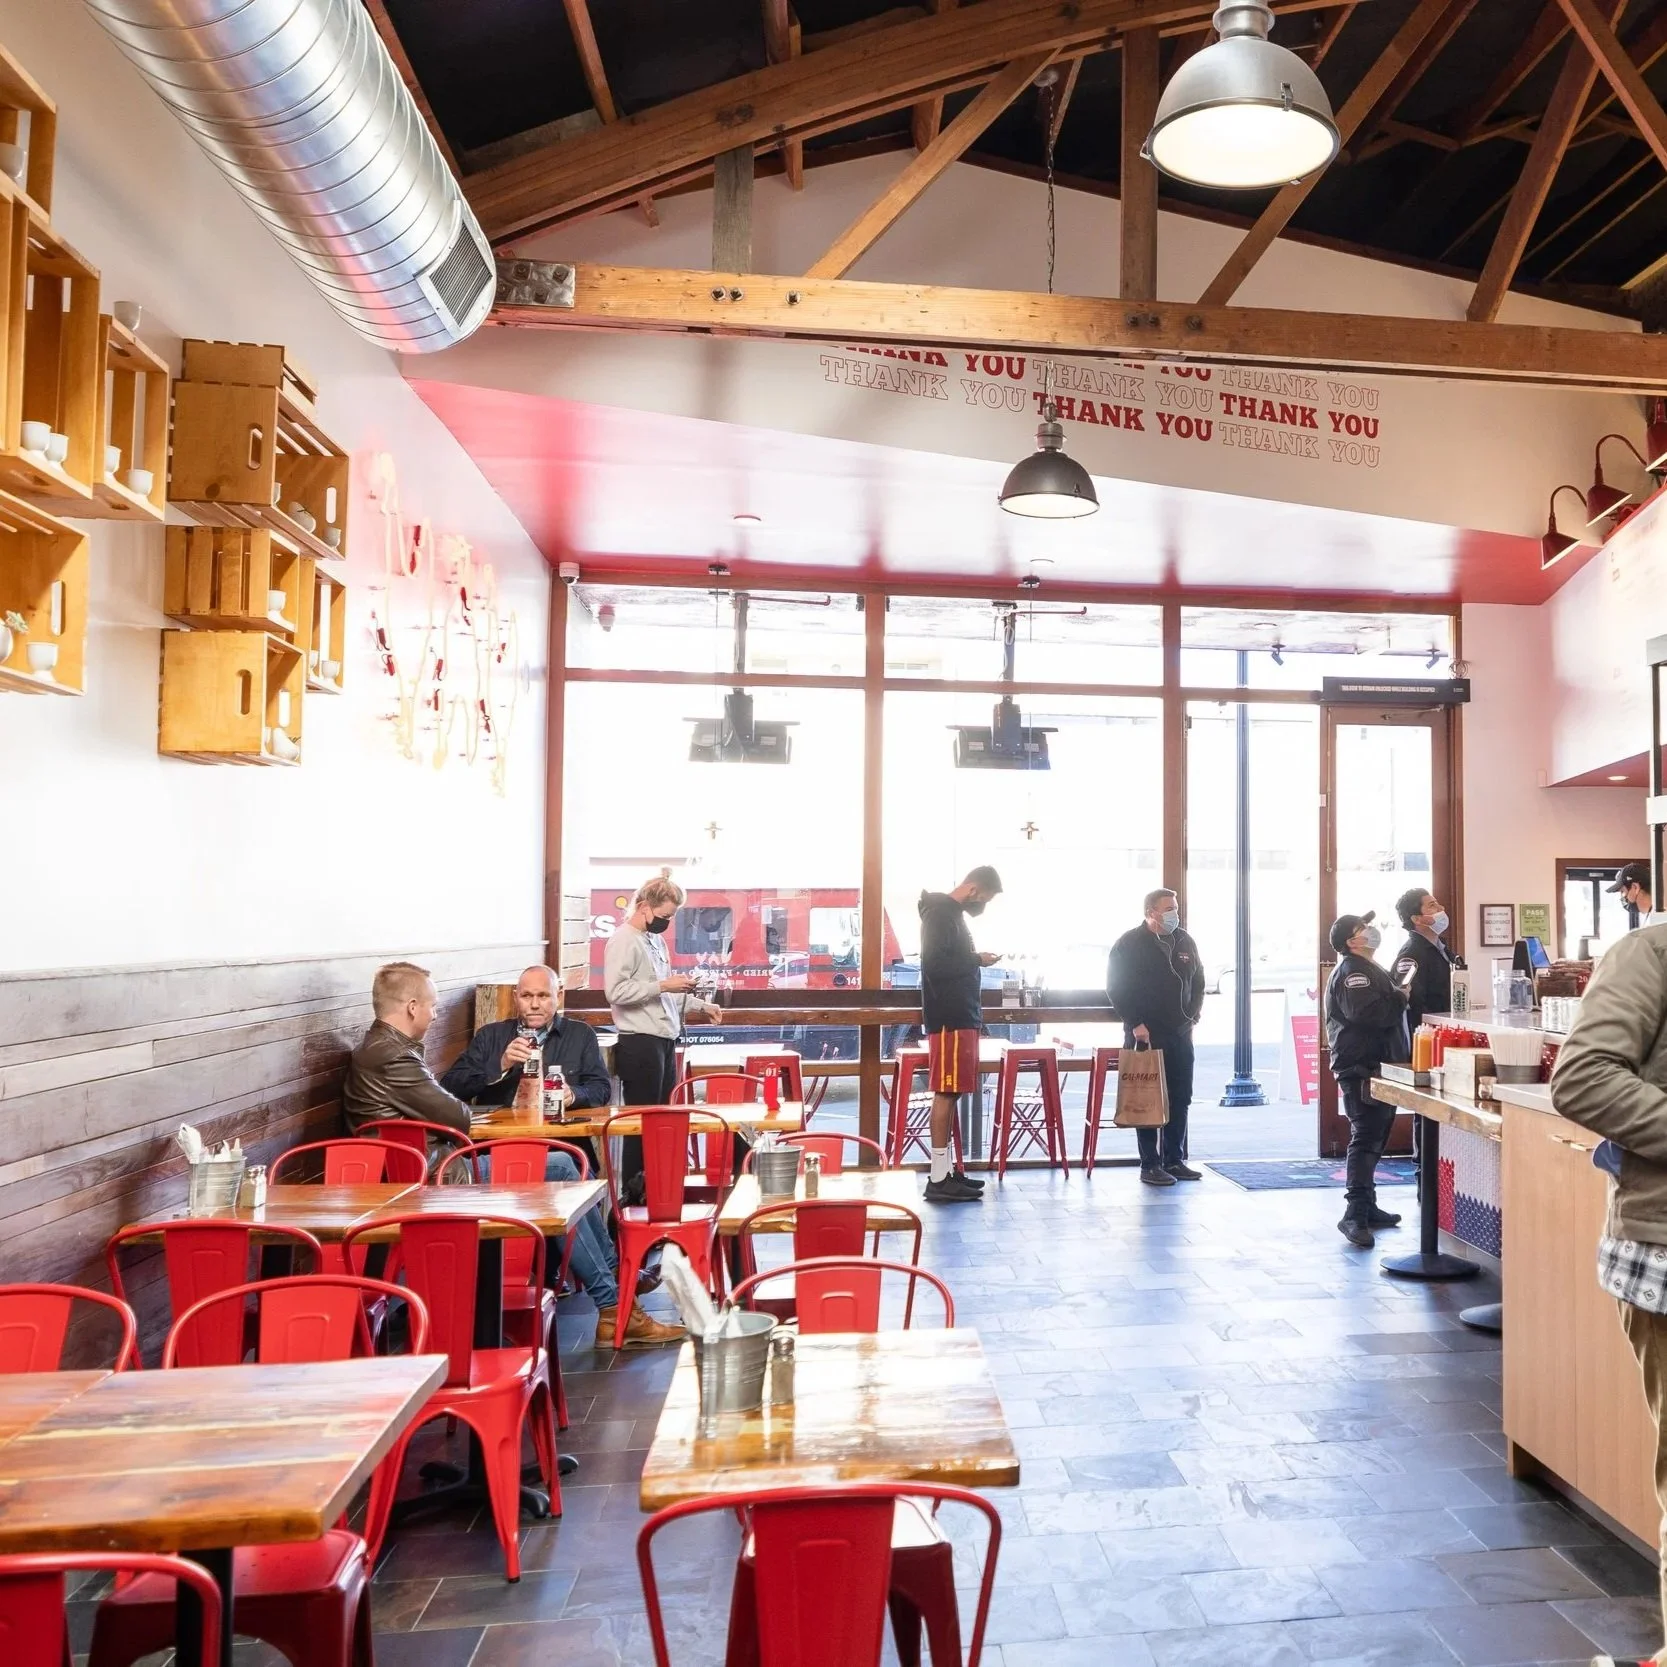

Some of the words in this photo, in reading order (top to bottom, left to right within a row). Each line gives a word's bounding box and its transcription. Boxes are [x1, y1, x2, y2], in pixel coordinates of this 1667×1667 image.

[820, 355, 948, 400] THANK
[960, 379, 1026, 412] YOU
[1032, 392, 1145, 432] THANK
[1156, 412, 1213, 442] YOU
[1219, 422, 1320, 459] THANK
[1328, 439, 1380, 468] YOU
[964, 354, 1026, 380] YOU
[1032, 360, 1146, 402] THANK
[1155, 381, 1213, 413] YOU
[1219, 392, 1319, 429] THANK
[1328, 411, 1379, 439] YOU
[1218, 369, 1319, 401] THANK
[1327, 381, 1379, 411] YOU
